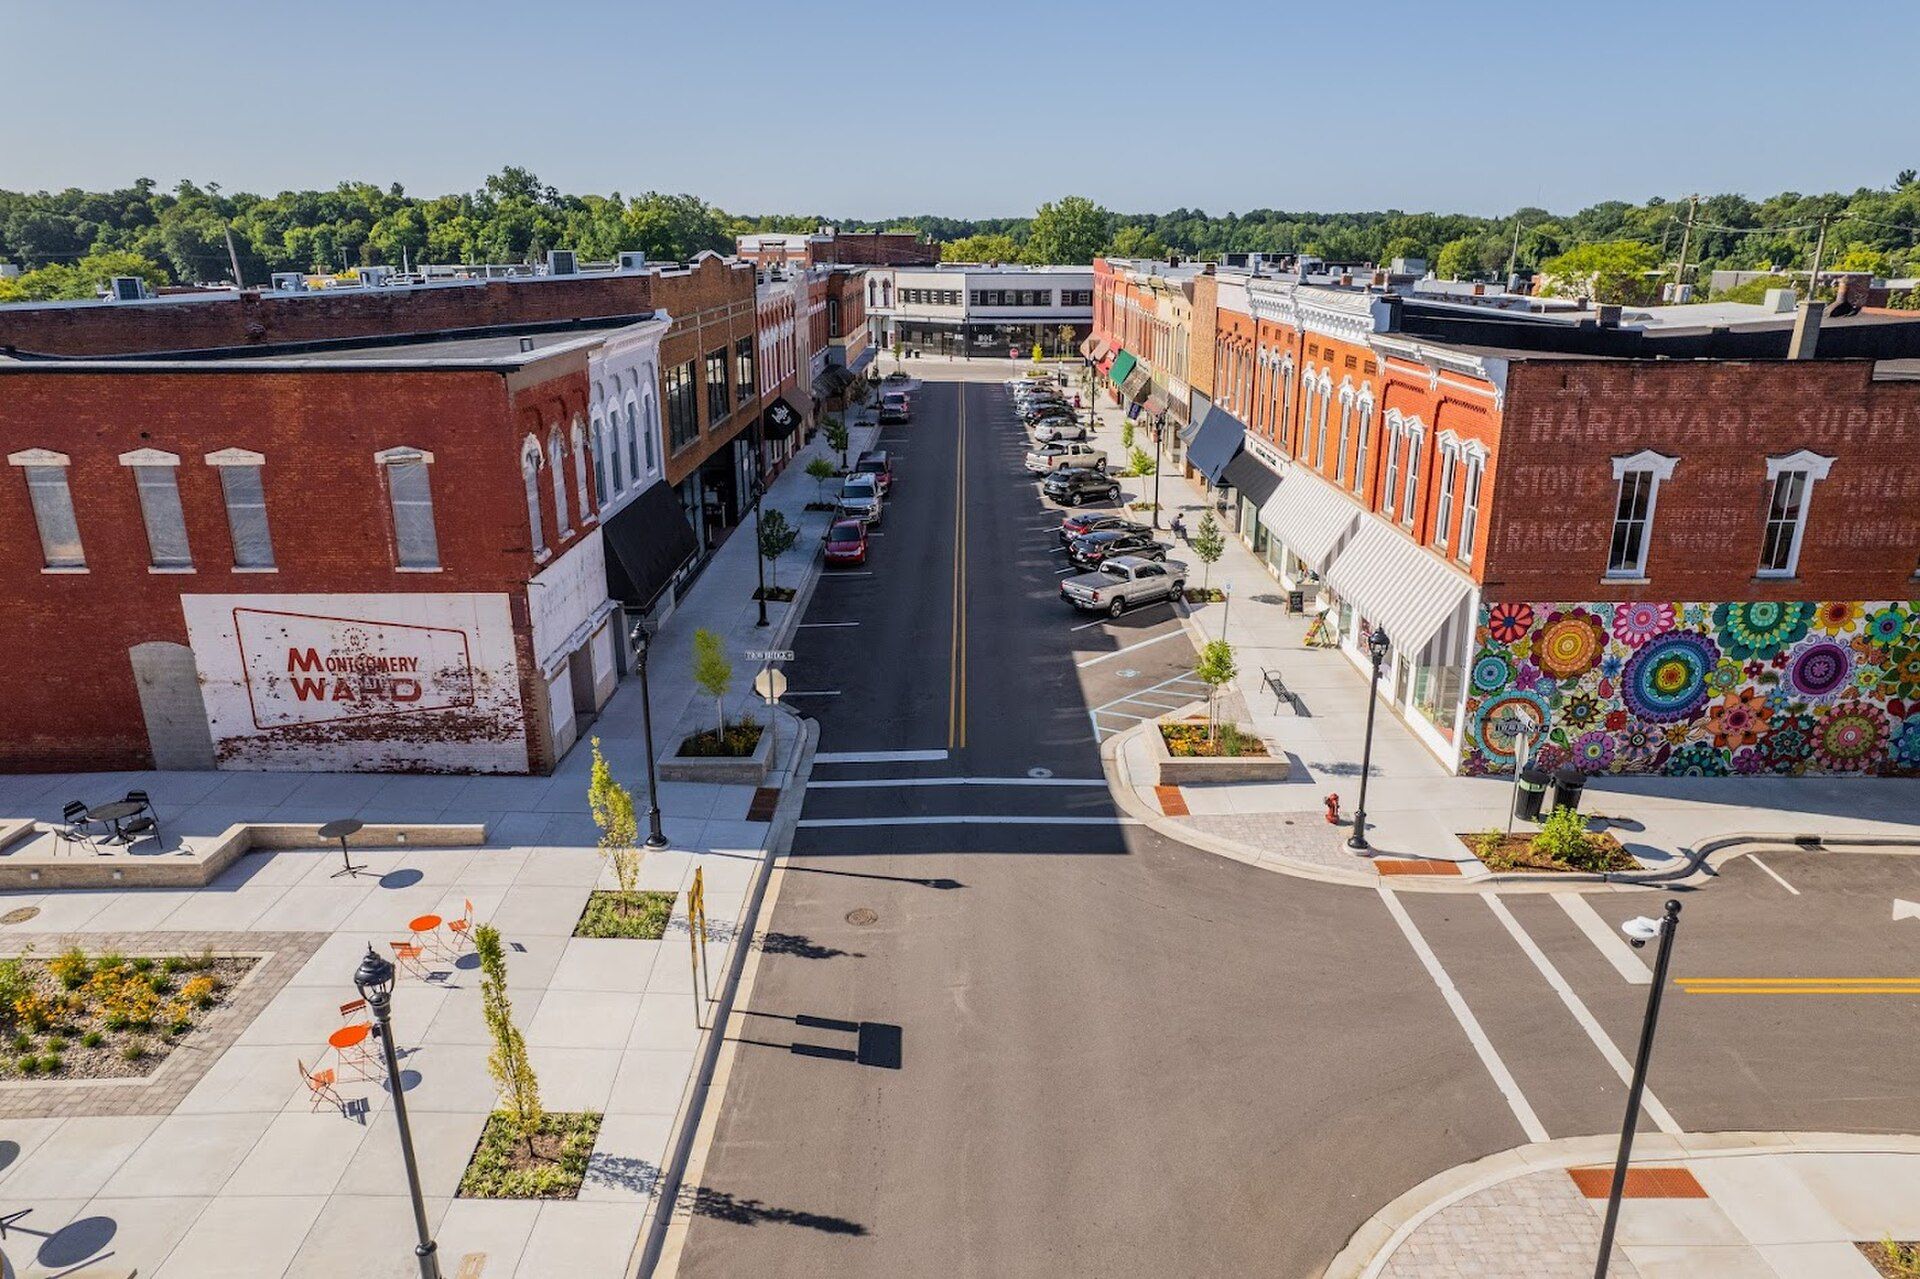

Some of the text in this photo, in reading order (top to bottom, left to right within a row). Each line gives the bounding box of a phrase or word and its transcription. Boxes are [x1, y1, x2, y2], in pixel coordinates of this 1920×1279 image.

[1529, 405, 1773, 444] HARDWARE
[1506, 520, 1606, 553] RANGES
[287, 647, 418, 672] MONTGOMERY
